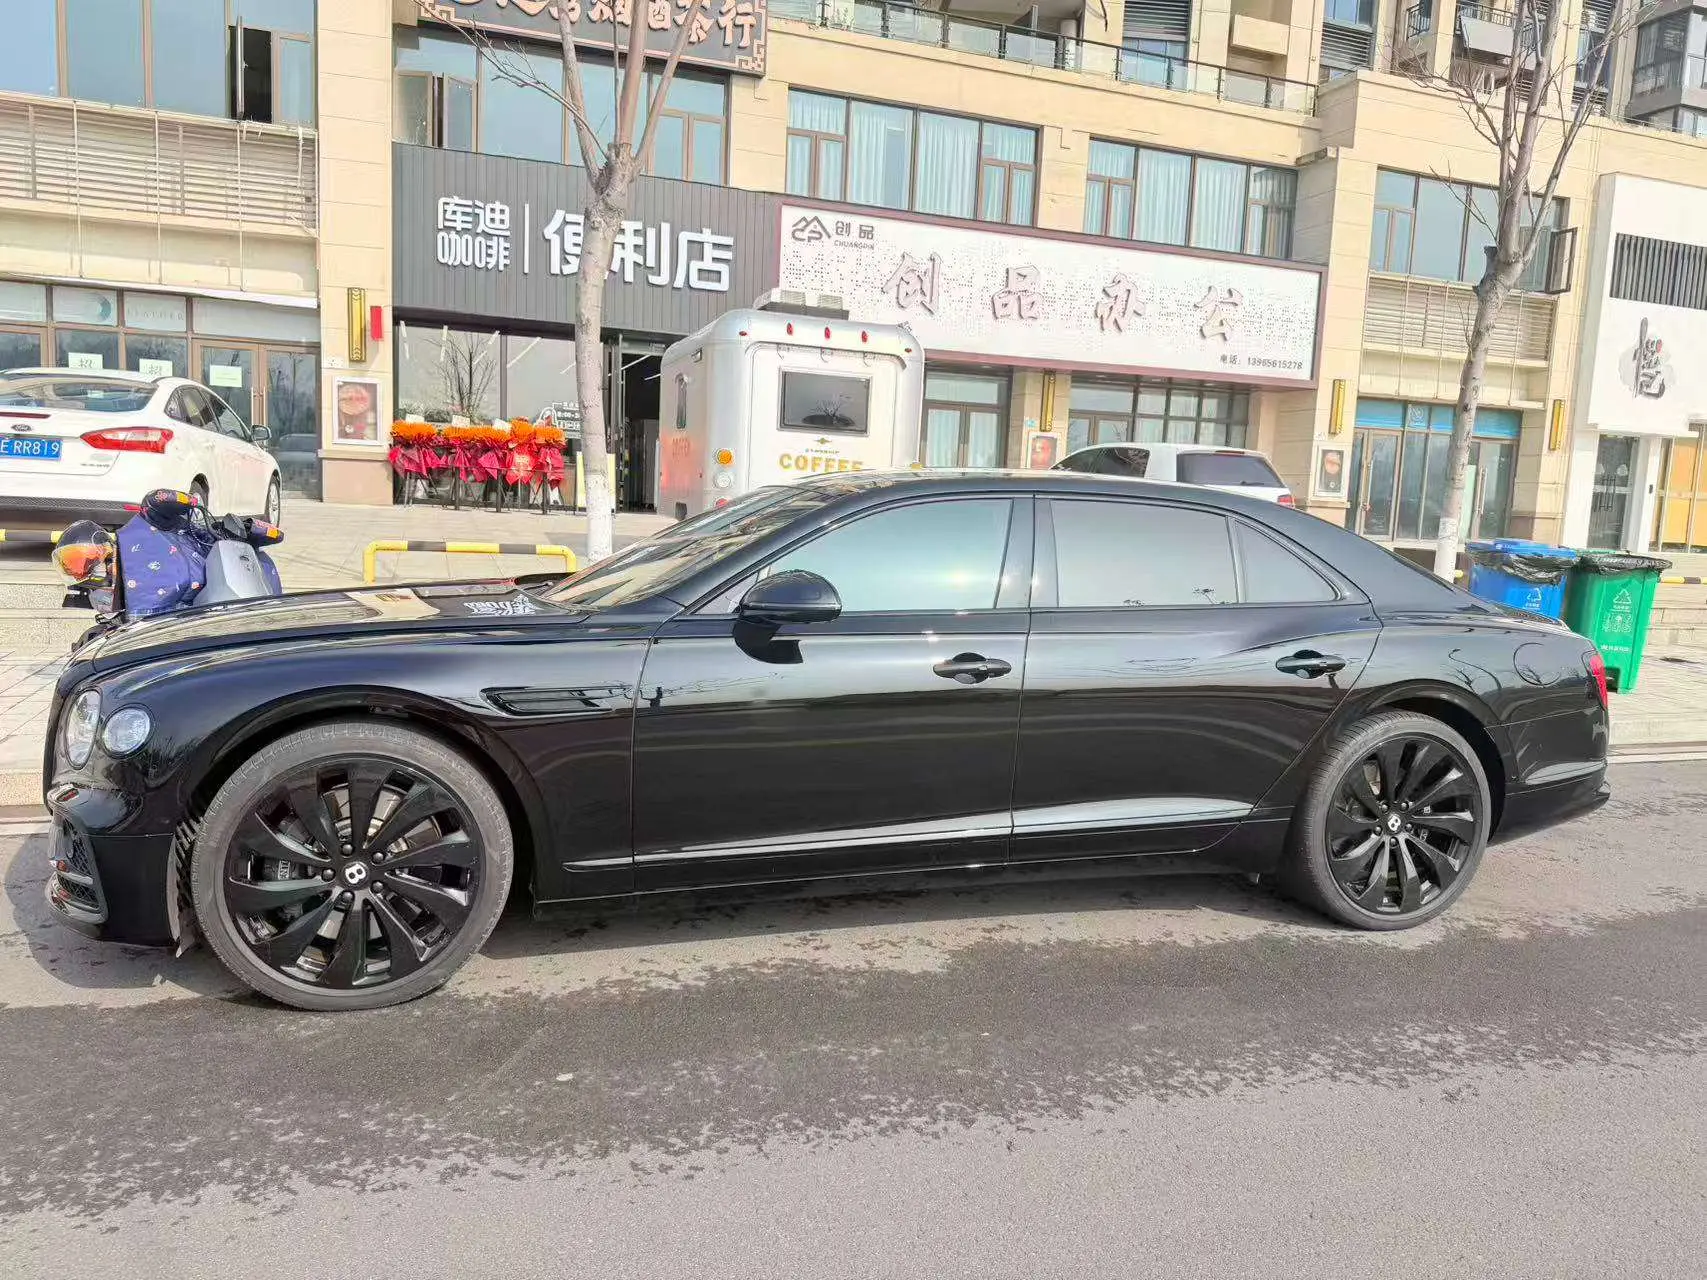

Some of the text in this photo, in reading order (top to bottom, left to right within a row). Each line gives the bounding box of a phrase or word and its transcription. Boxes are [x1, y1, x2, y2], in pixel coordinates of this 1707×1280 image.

[437, 197, 510, 234] 库迪
[834, 220, 875, 239] 创品
[437, 231, 510, 271] 咖啡
[543, 209, 734, 291] 便利店
[345, 863, 366, 883] B
